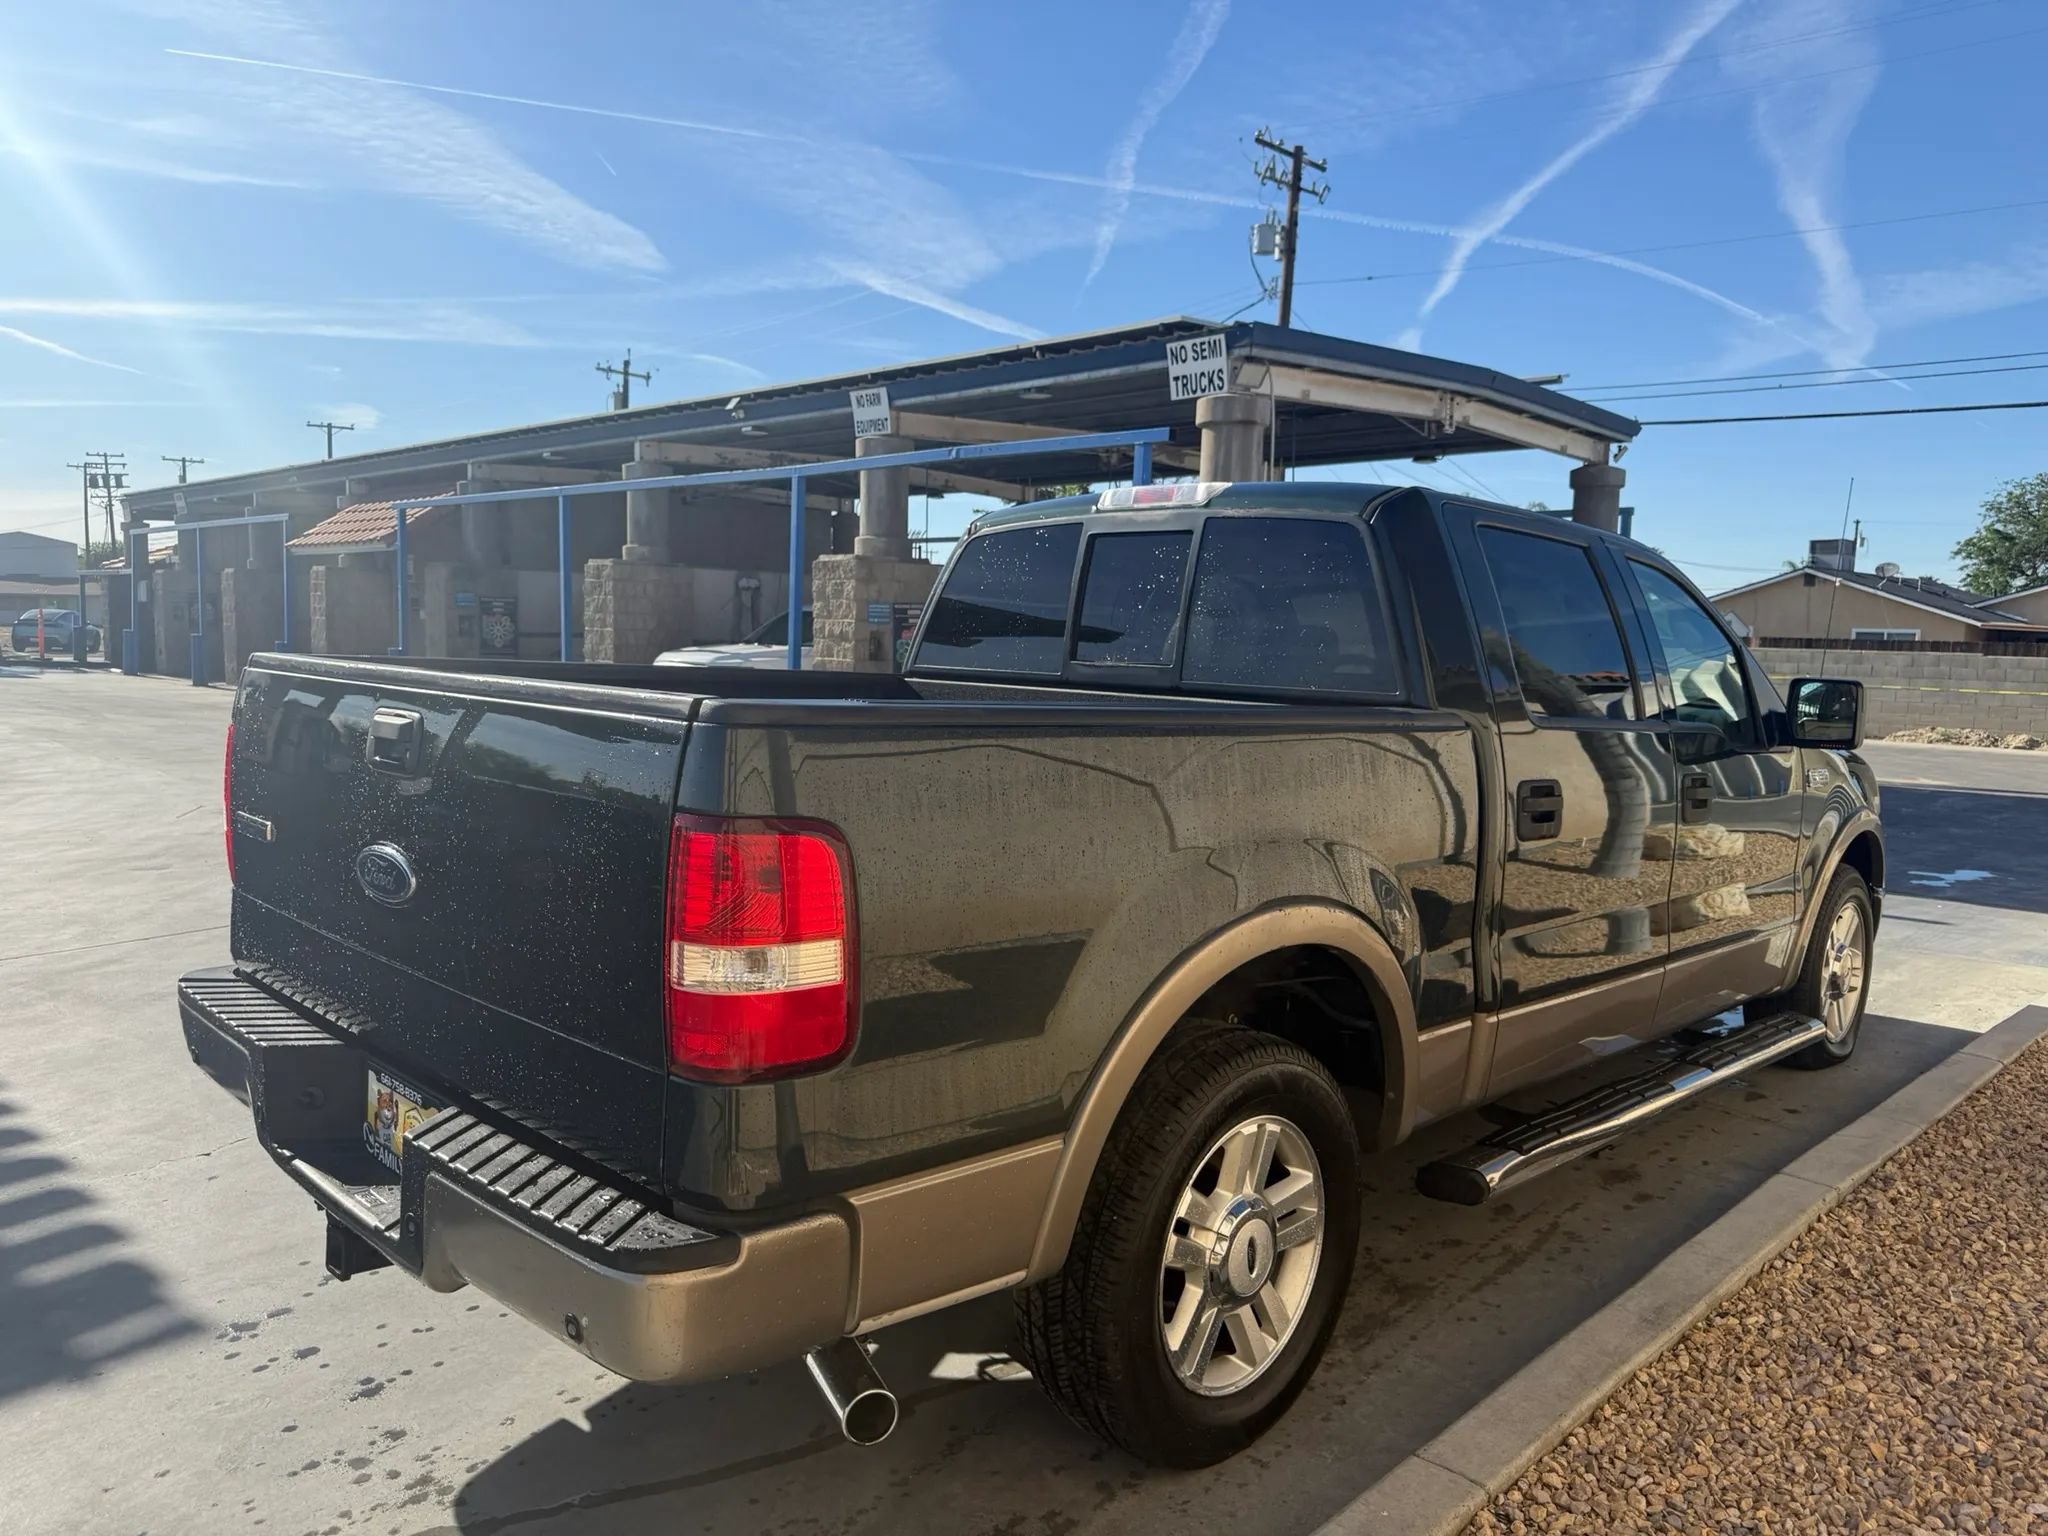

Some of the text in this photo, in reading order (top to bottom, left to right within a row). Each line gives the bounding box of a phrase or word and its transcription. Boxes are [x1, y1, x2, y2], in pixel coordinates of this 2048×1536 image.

[1169, 338, 1222, 366] NO SEMI
[1172, 368, 1225, 398] TRUCKS
[855, 392, 882, 408] NO FARM
[856, 417, 889, 434] EQUIPMENT
